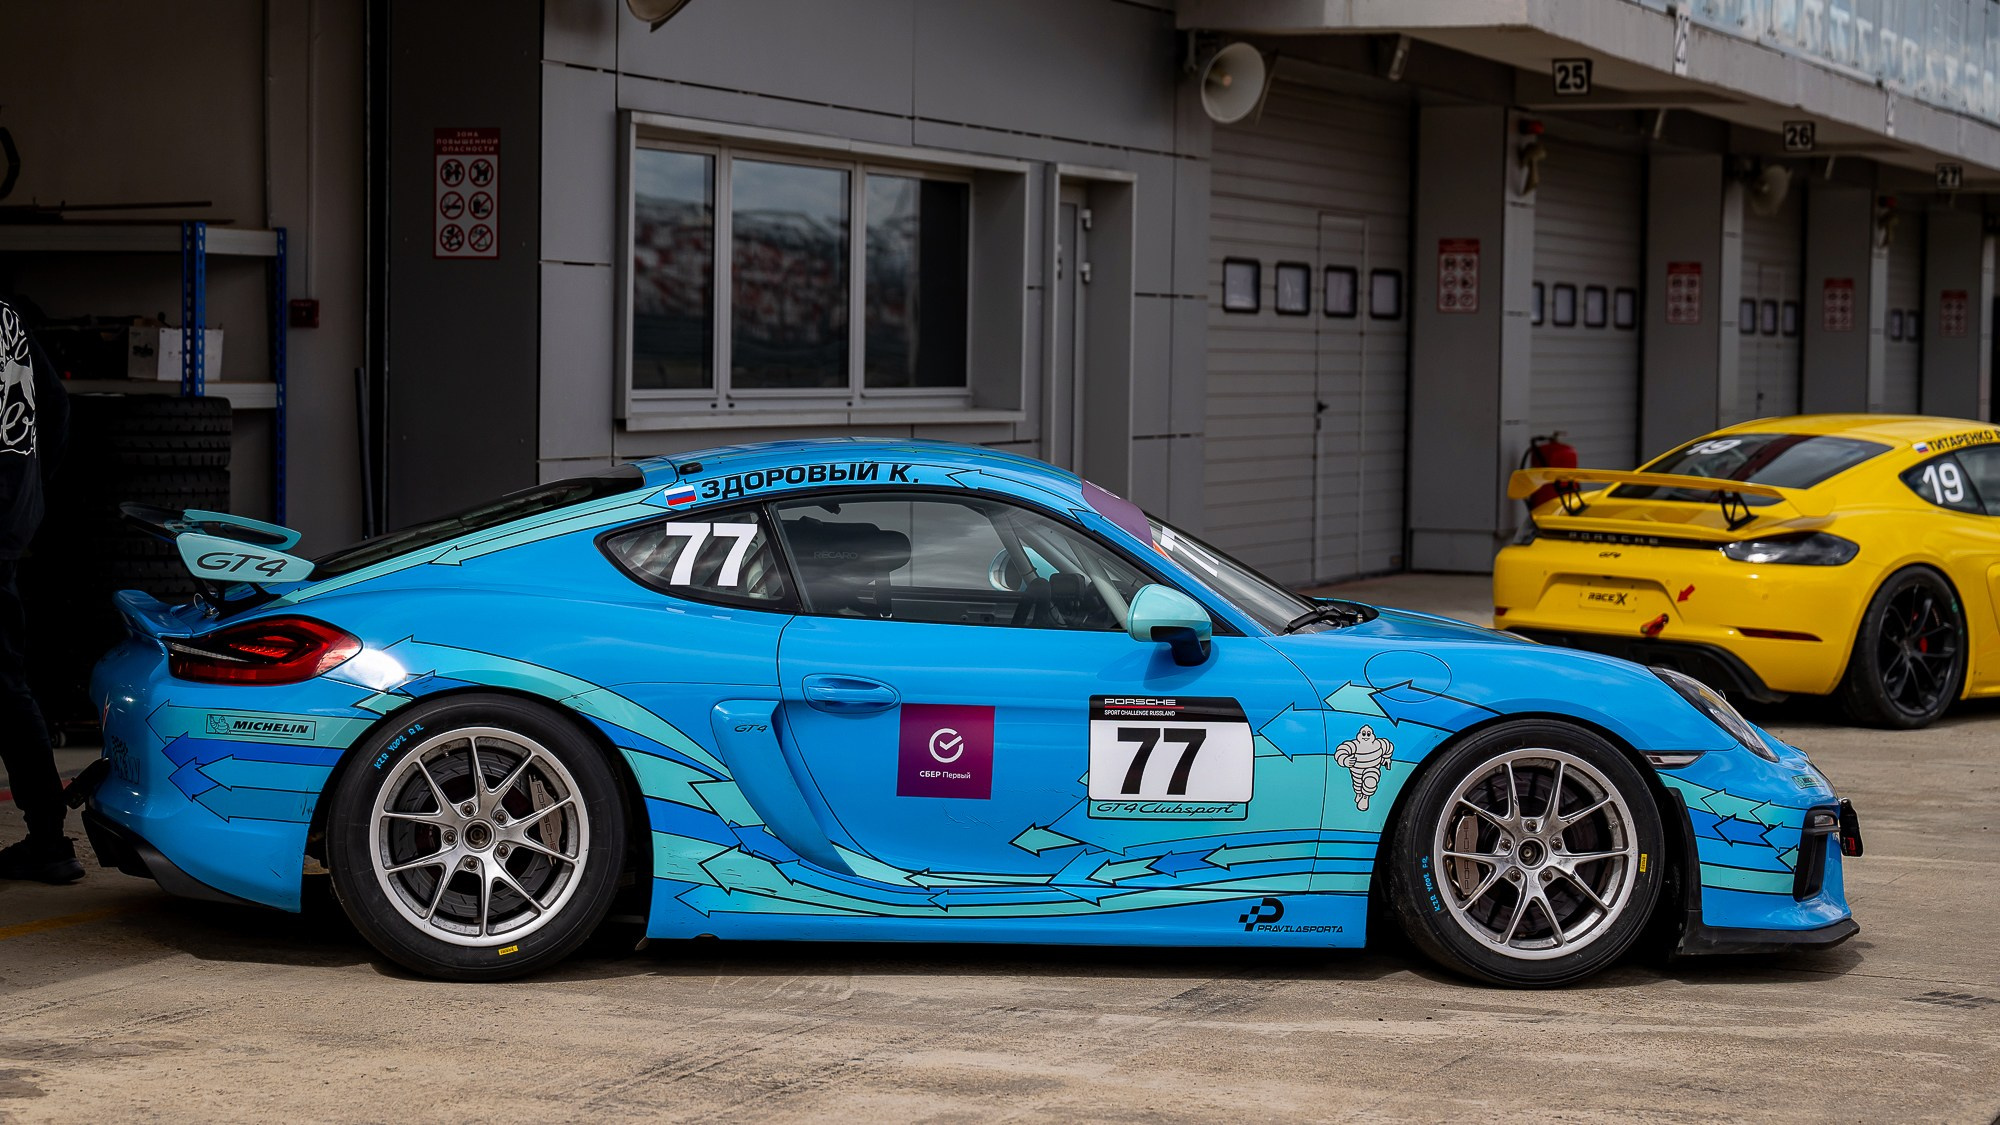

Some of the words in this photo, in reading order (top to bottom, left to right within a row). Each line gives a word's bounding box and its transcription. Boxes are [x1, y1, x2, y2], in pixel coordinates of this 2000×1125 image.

[1557, 64, 1585, 89] 25
[436, 137, 499, 145] ПОВЫШЕННОЙ
[1786, 127, 1810, 146] 26
[1939, 166, 1959, 184] 27
[1685, 439, 1742, 455] 19
[701, 461, 880, 500] ЗДОРОВЫЙ
[888, 464, 920, 484] К.
[1922, 462, 1964, 504] 19
[666, 522, 758, 587] 77
[813, 551, 858, 560] RECARO
[196, 552, 288, 577] GT4
[1104, 698, 1176, 706] PORSCHE
[233, 720, 309, 734] MICHELIN
[734, 724, 768, 733] GT4
[1117, 727, 1207, 796] 77
[919, 770, 941, 778] СБЕР
[942, 771, 971, 779] Первый
[1097, 803, 1138, 813] GT4
[1139, 803, 1238, 817] Clubsport
[1257, 925, 1344, 933] PRAVILASPORTA
